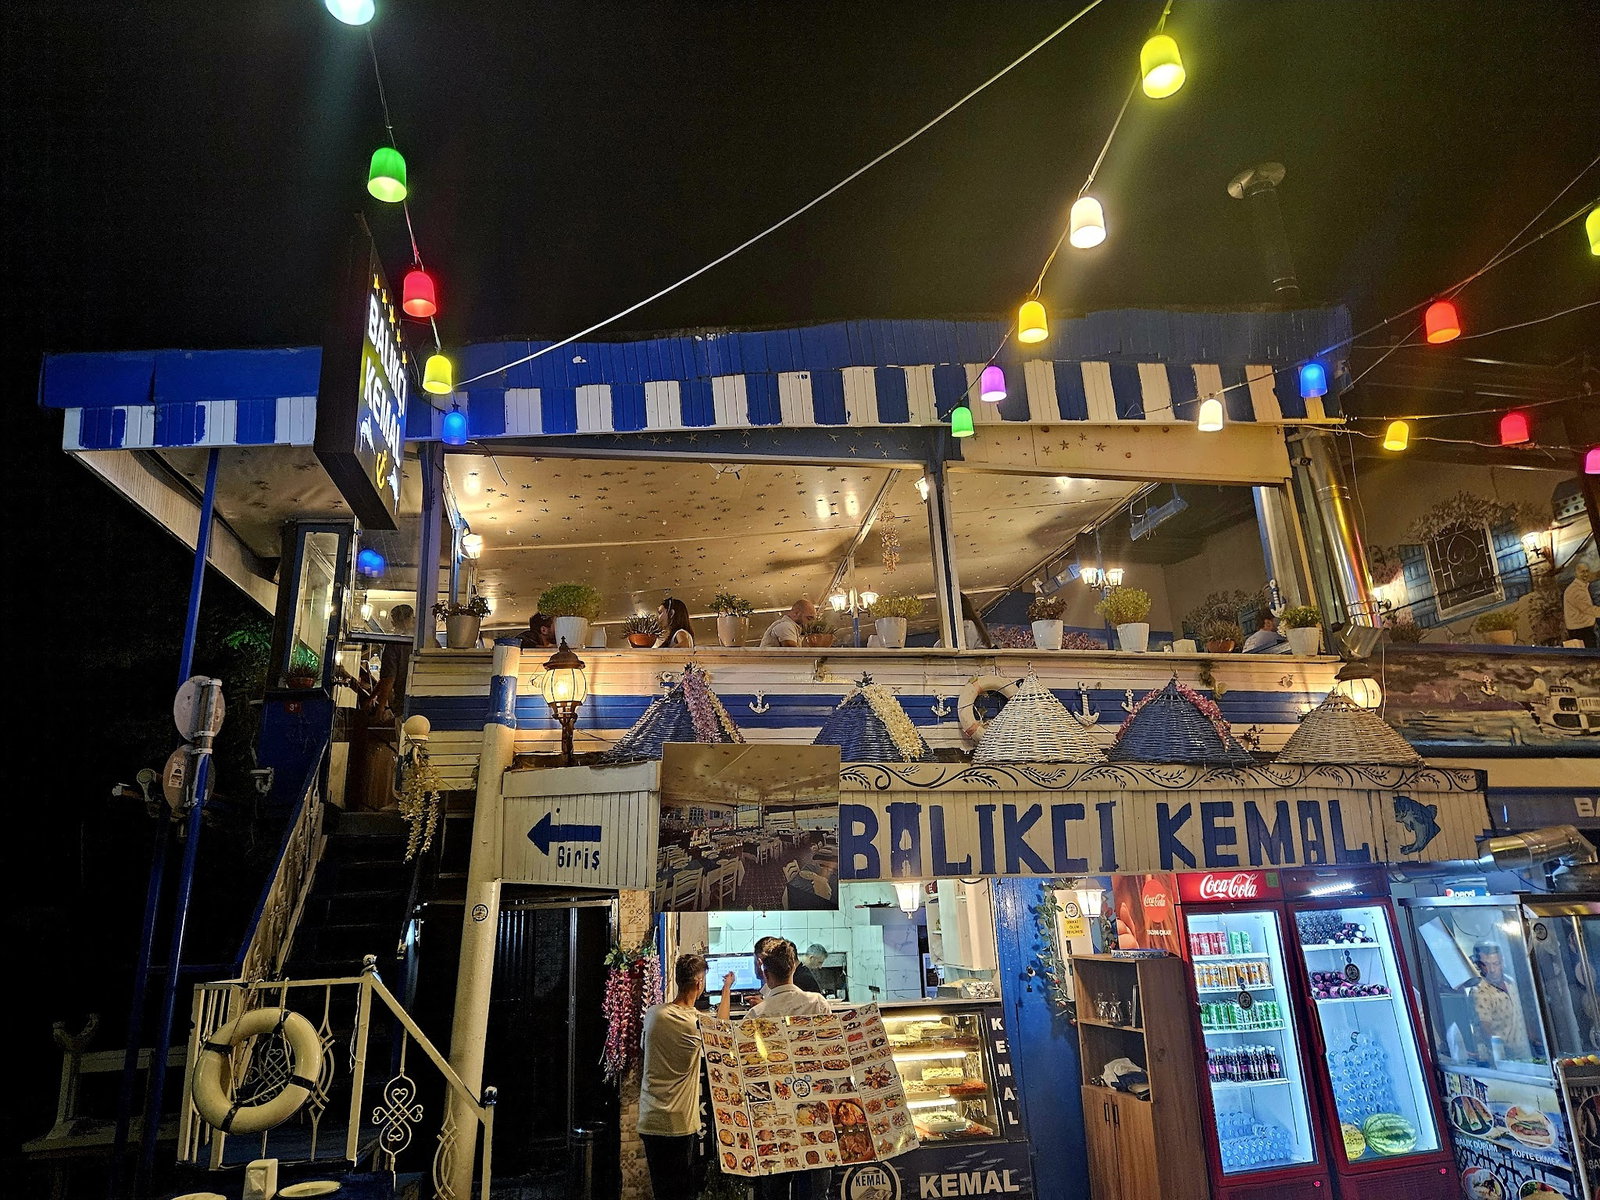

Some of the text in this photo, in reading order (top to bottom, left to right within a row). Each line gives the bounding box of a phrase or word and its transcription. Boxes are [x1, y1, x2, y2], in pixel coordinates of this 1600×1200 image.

[364, 356, 401, 468] KEMAL
[1573, 797, 1600, 818] B
[1156, 800, 1371, 870] KEMAL
[557, 845, 600, 871] Giriş
[1200, 873, 1259, 899] Coca-Cola
[990, 1017, 1019, 1125] KEMAL
[855, 1174, 887, 1187] KEMAL
[919, 1169, 1020, 1199] KEMAL
